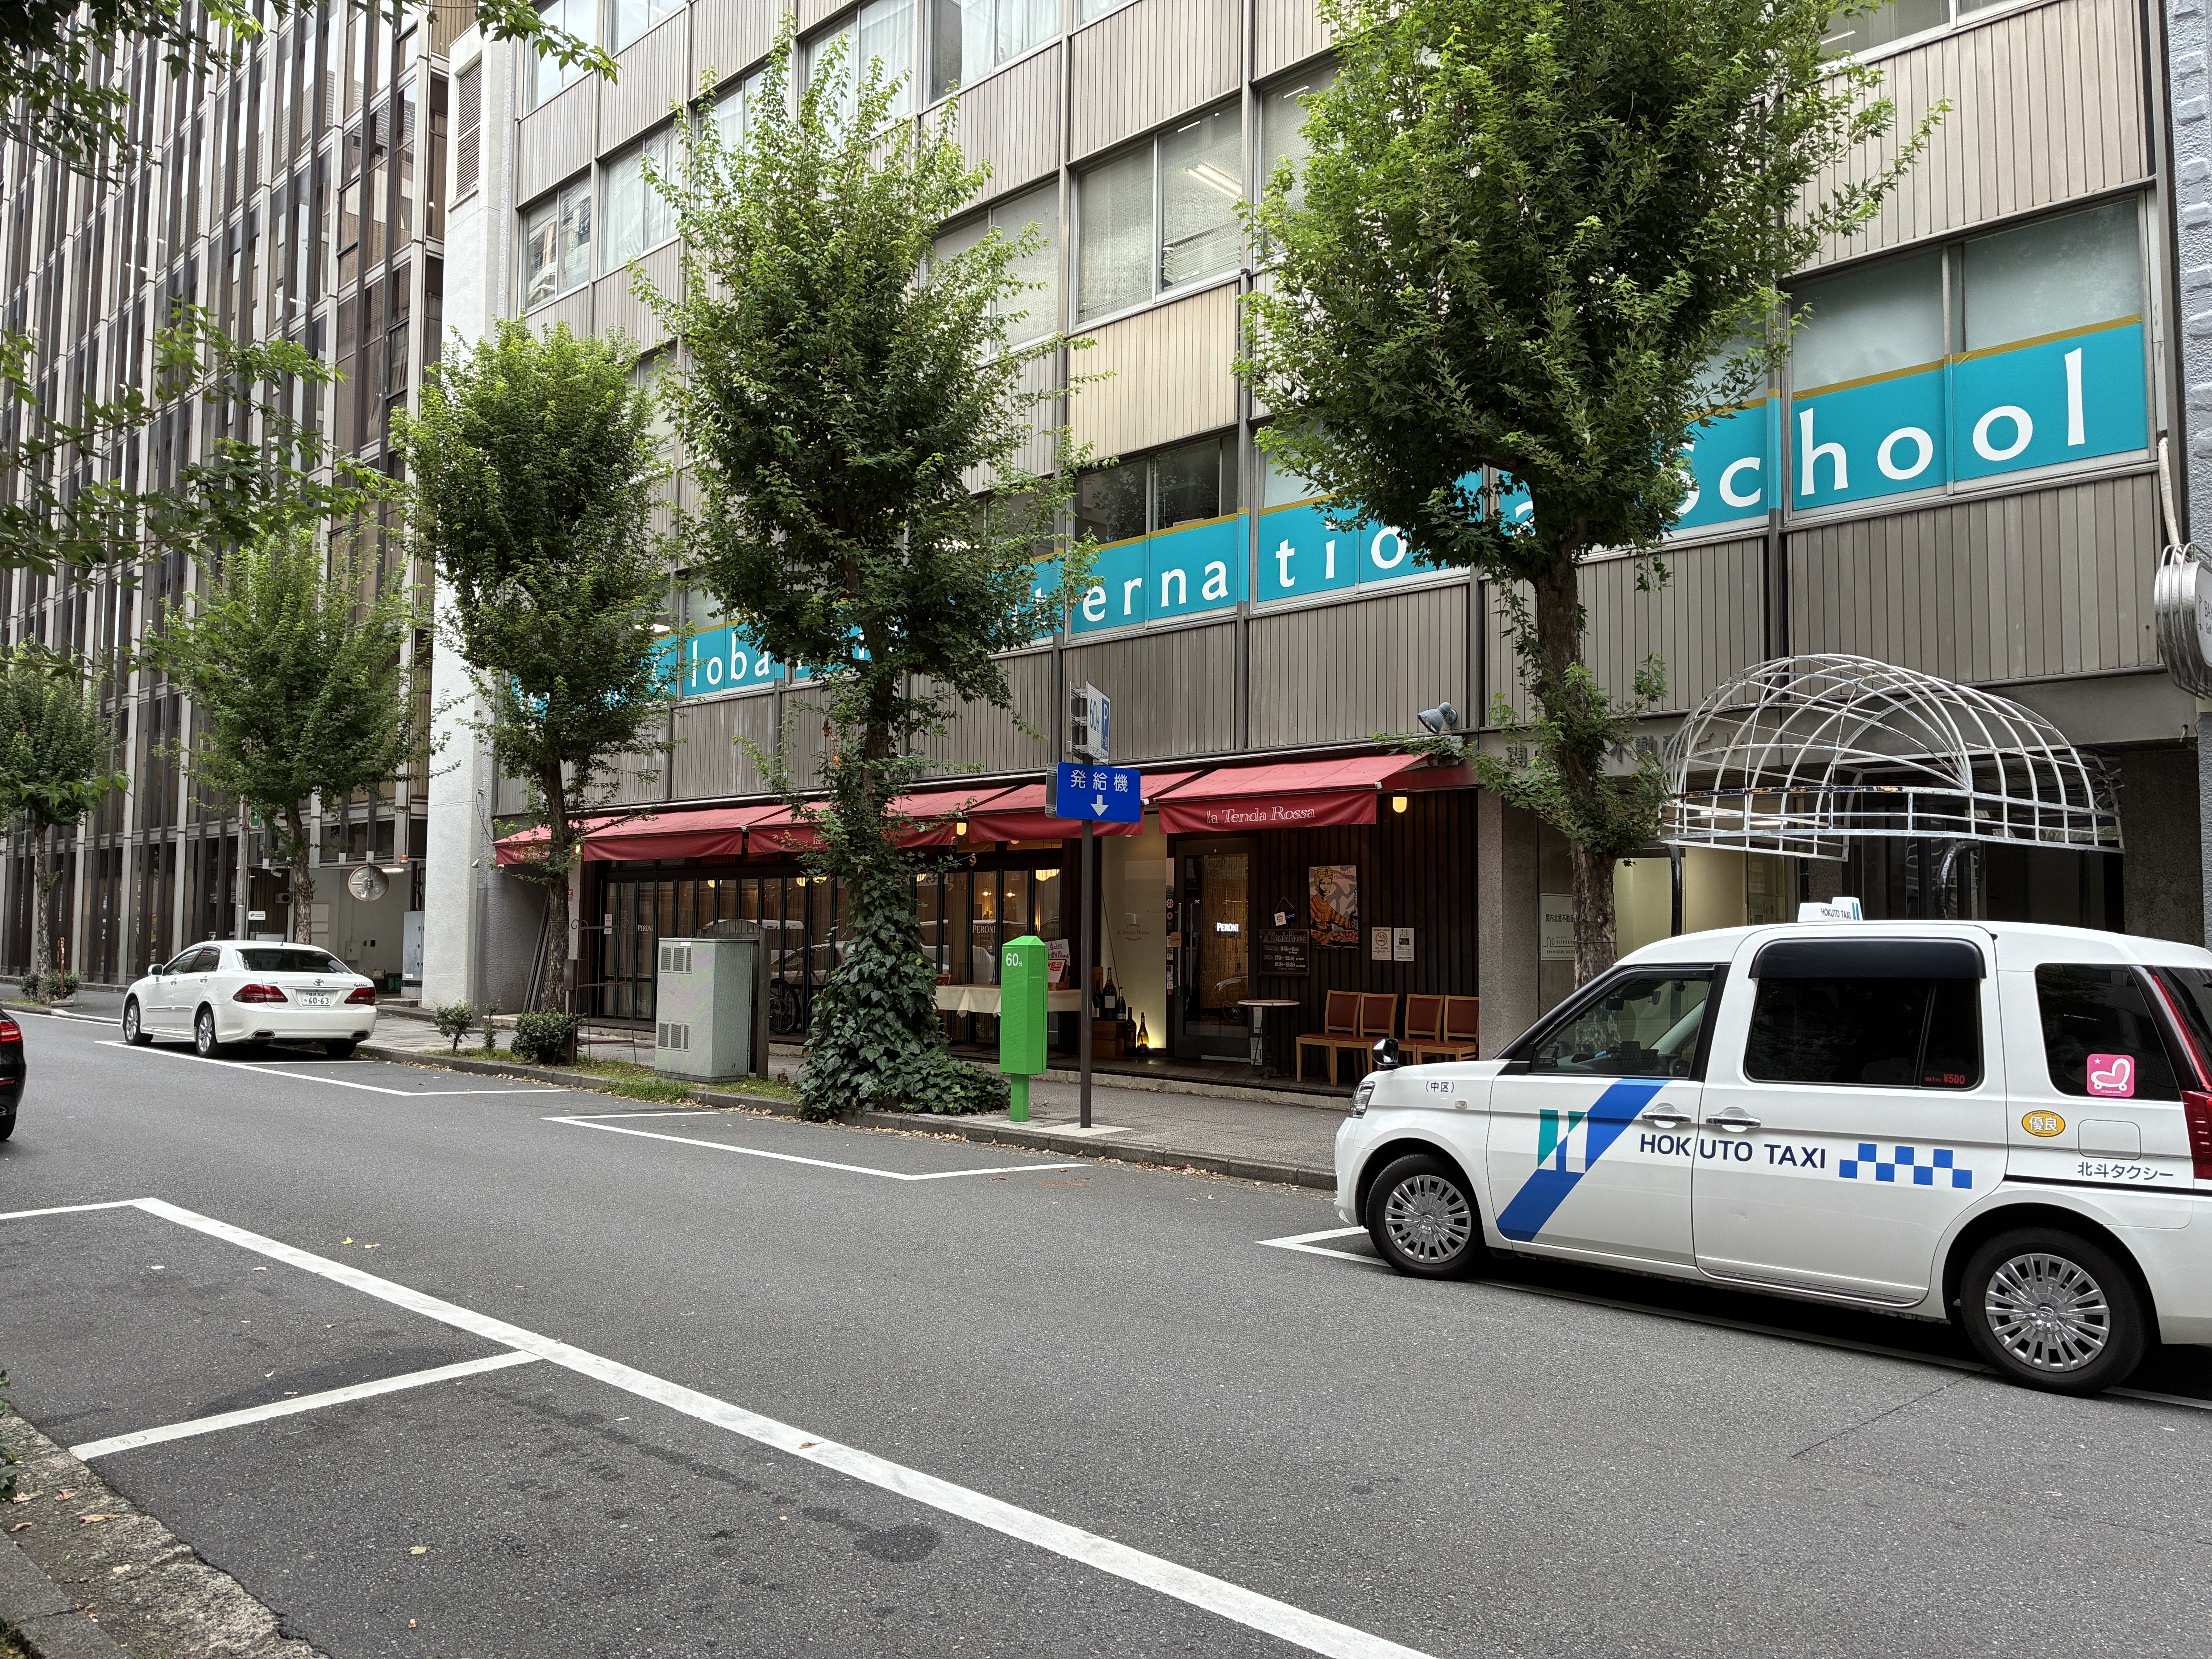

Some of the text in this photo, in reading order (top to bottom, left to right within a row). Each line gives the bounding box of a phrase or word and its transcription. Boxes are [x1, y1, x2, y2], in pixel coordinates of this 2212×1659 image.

[644, 627, 804, 691] loba
[1071, 769, 1128, 793] 発給機
[1207, 806, 1316, 824] la Tenda Rossa
[1821, 908, 1851, 919] HOKUTO TAXI
[972, 924, 996, 934] PERONI
[1217, 922, 1239, 932] PERONI
[1006, 953, 1023, 967] 60分
[1943, 1074, 1965, 1084] ¥500
[2029, 1116, 2058, 1132] 優良
[1764, 1144, 1826, 1169] TAXI
[2077, 1162, 2174, 1180] 北斗タクシー
